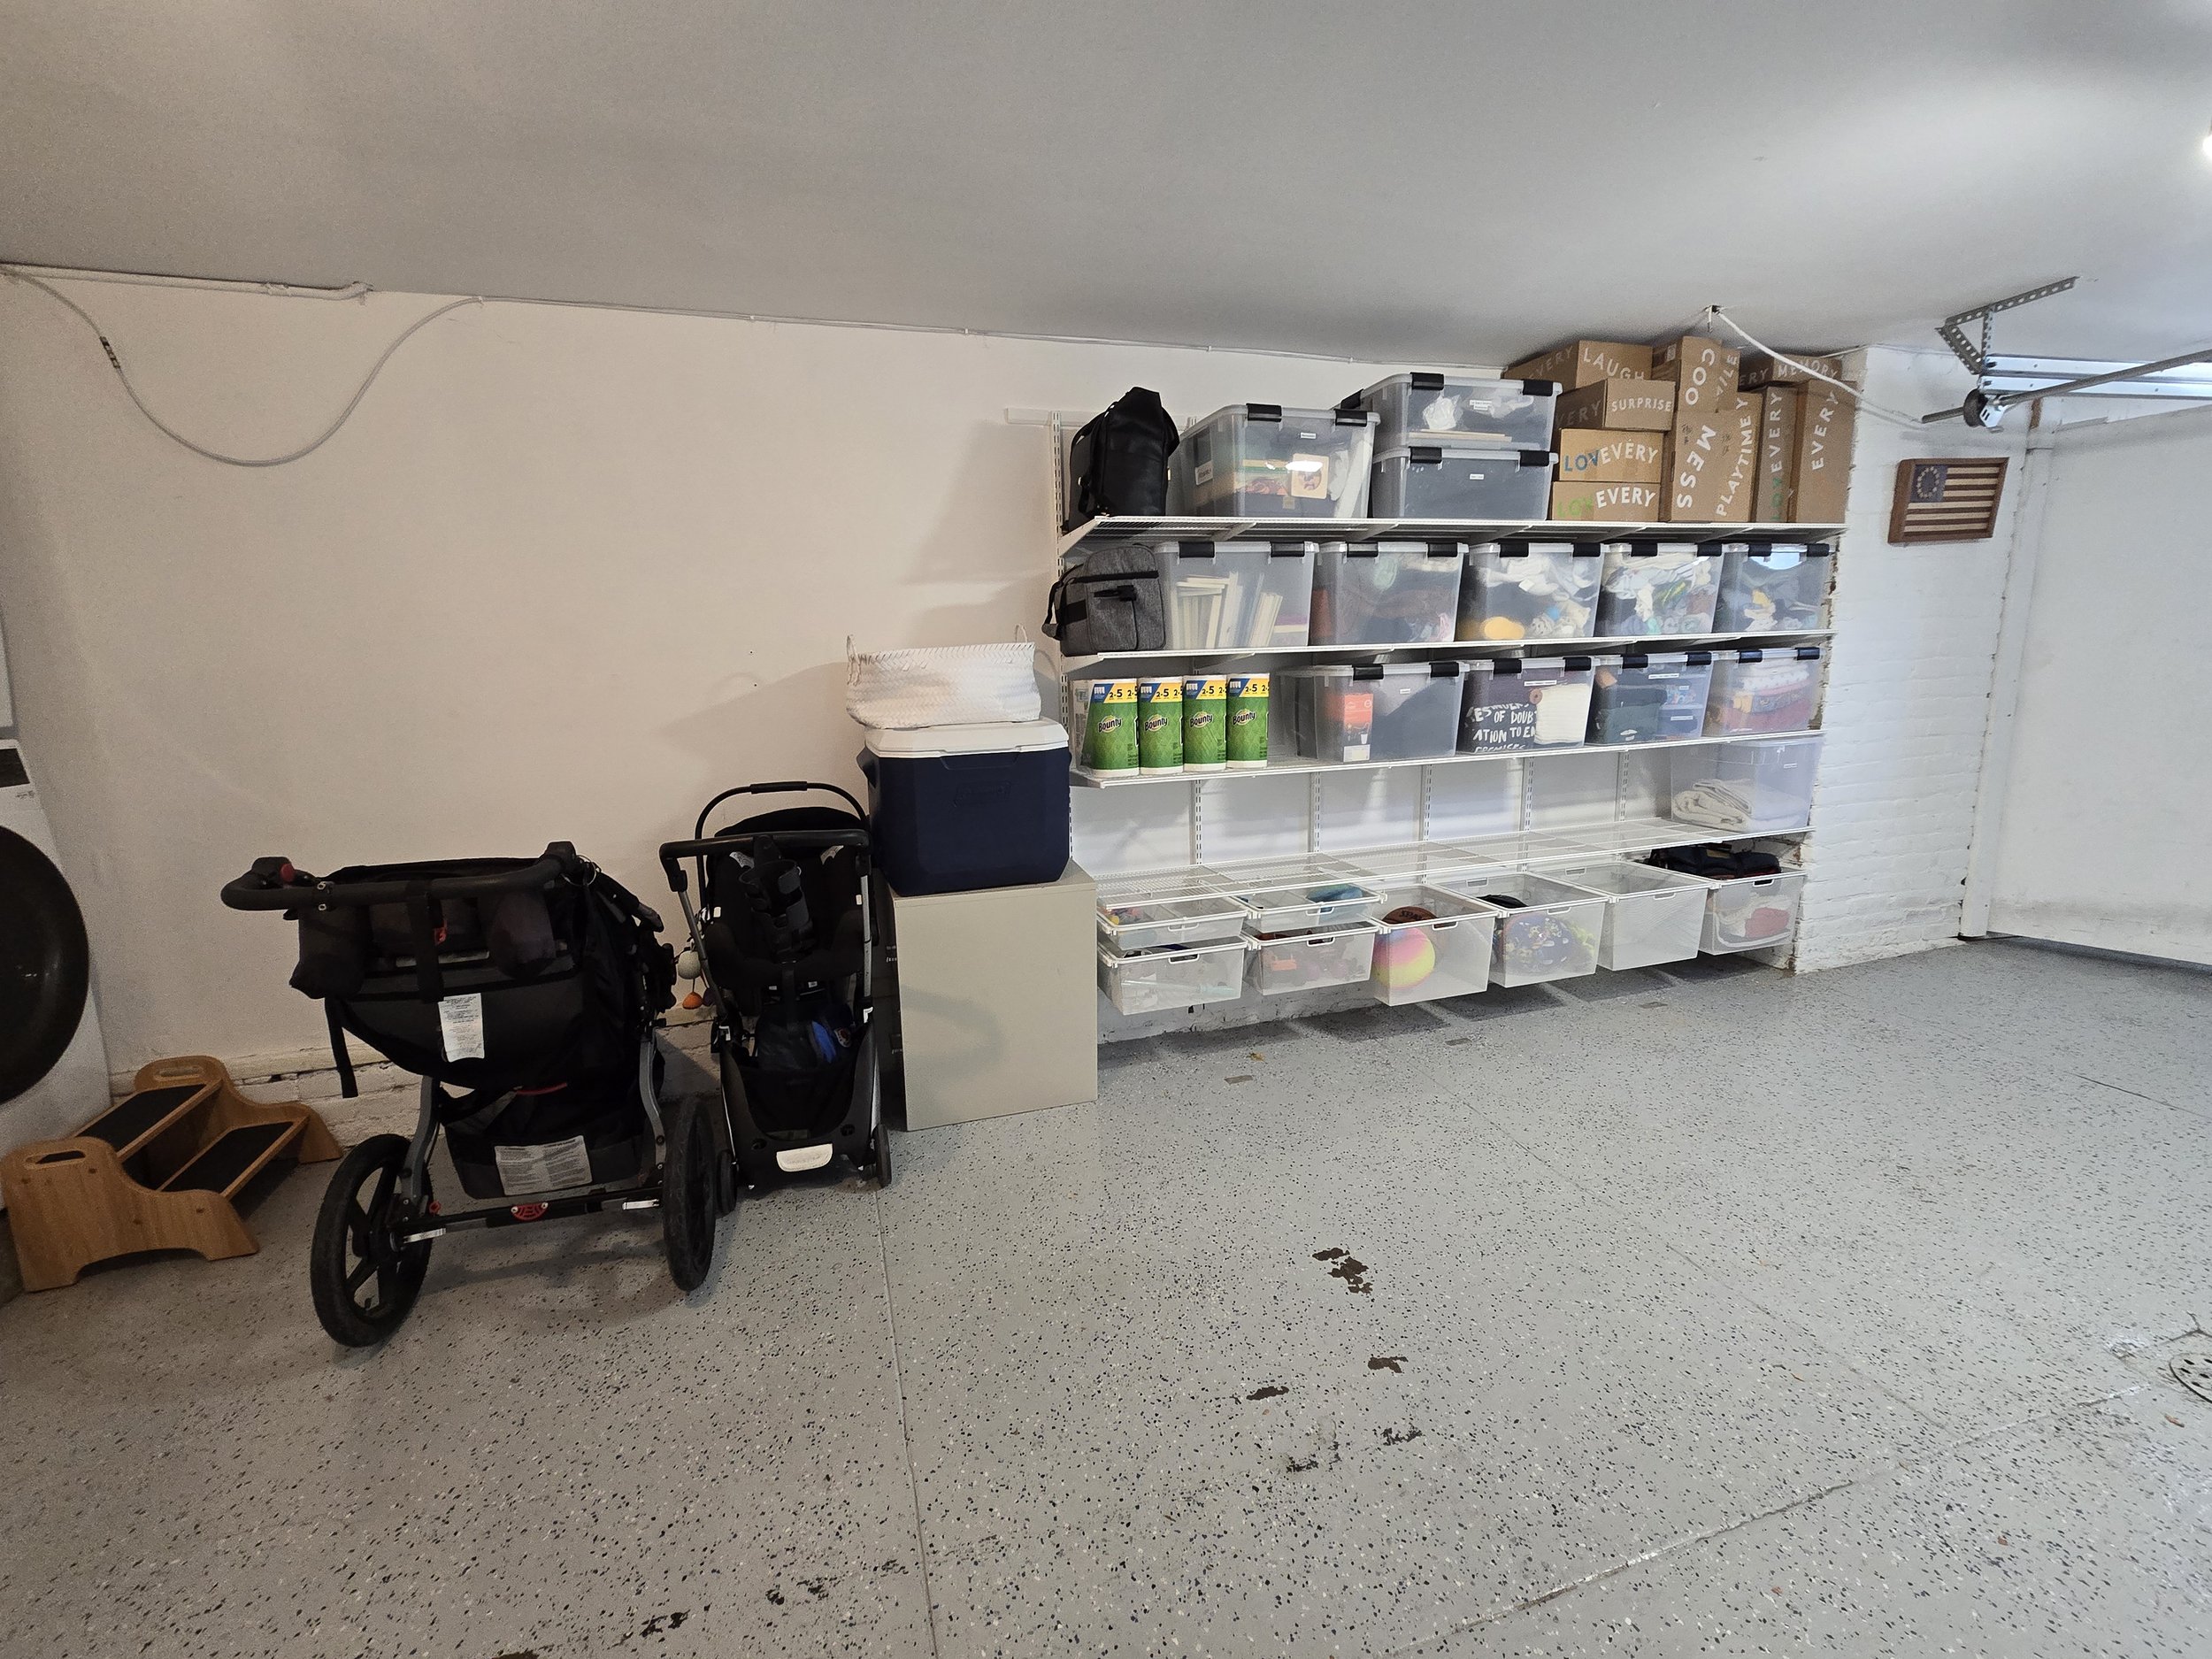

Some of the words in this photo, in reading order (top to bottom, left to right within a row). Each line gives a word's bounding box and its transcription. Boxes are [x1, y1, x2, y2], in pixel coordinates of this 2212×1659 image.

[1583, 348, 1645, 380] LAUGH
[1611, 397, 1672, 412] SURPRISE
[1676, 425, 1717, 508] MESS
[1716, 415, 1753, 517] PLAYTIME
[1189, 713, 1213, 727] Bounty
[1233, 710, 1256, 726] Bounty
[1494, 710, 1506, 723] OF
[1098, 717, 1122, 733] Bounty
[1144, 717, 1168, 732] Bounty
[1509, 726, 1522, 738] TO
